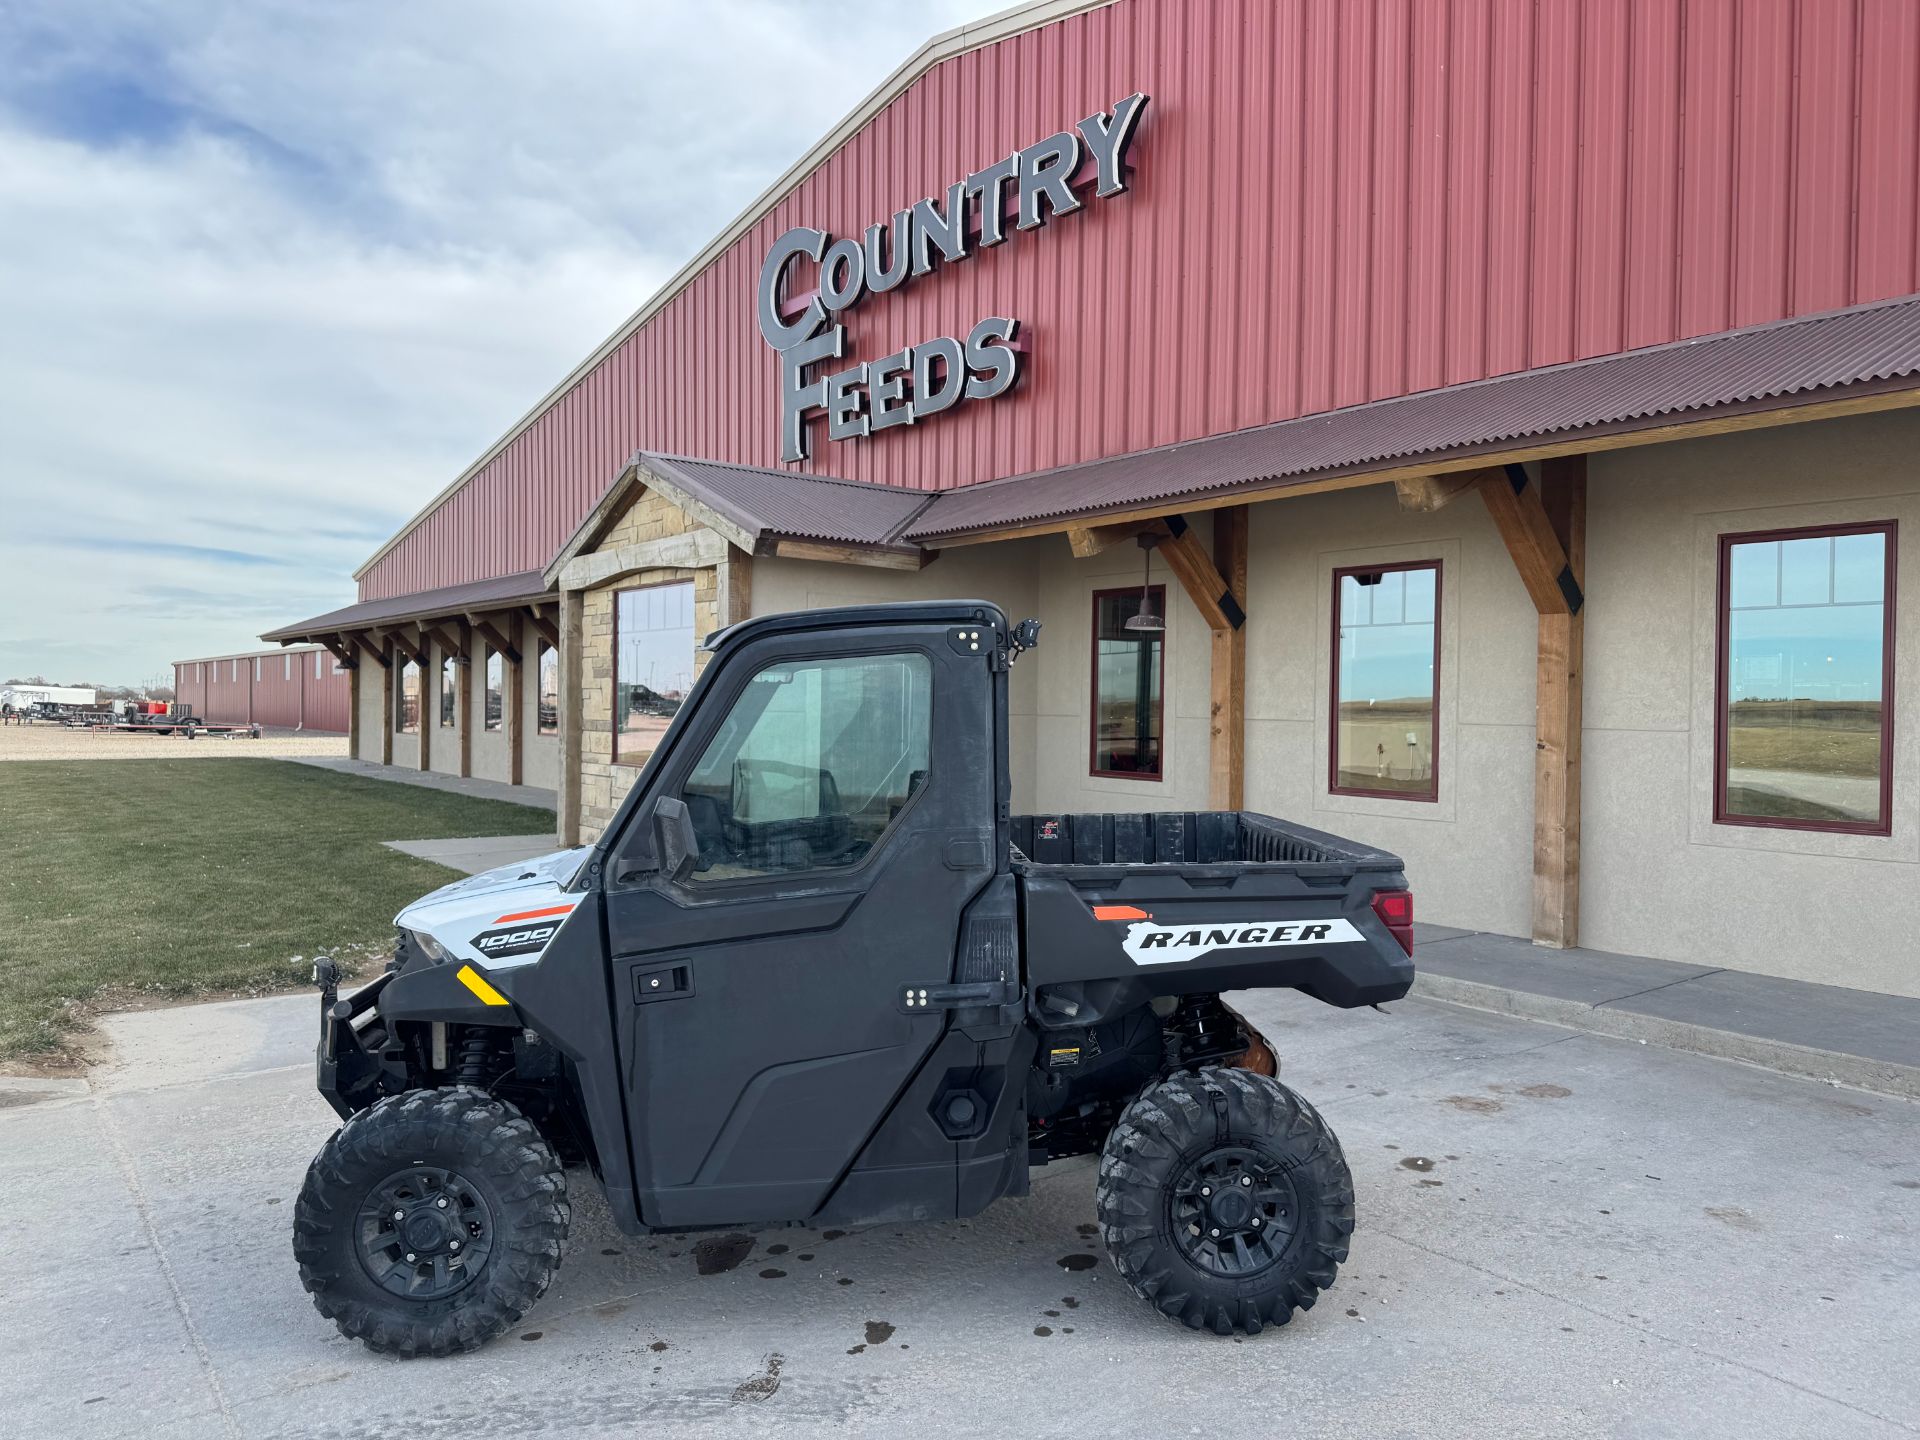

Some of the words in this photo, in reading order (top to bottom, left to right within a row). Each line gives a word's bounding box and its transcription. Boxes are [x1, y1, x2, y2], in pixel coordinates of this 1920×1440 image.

[757, 92, 1150, 352] COUNTRY
[780, 316, 1021, 463] FEEDS
[478, 927, 554, 948] 1000
[1139, 924, 1332, 949] RANGER
